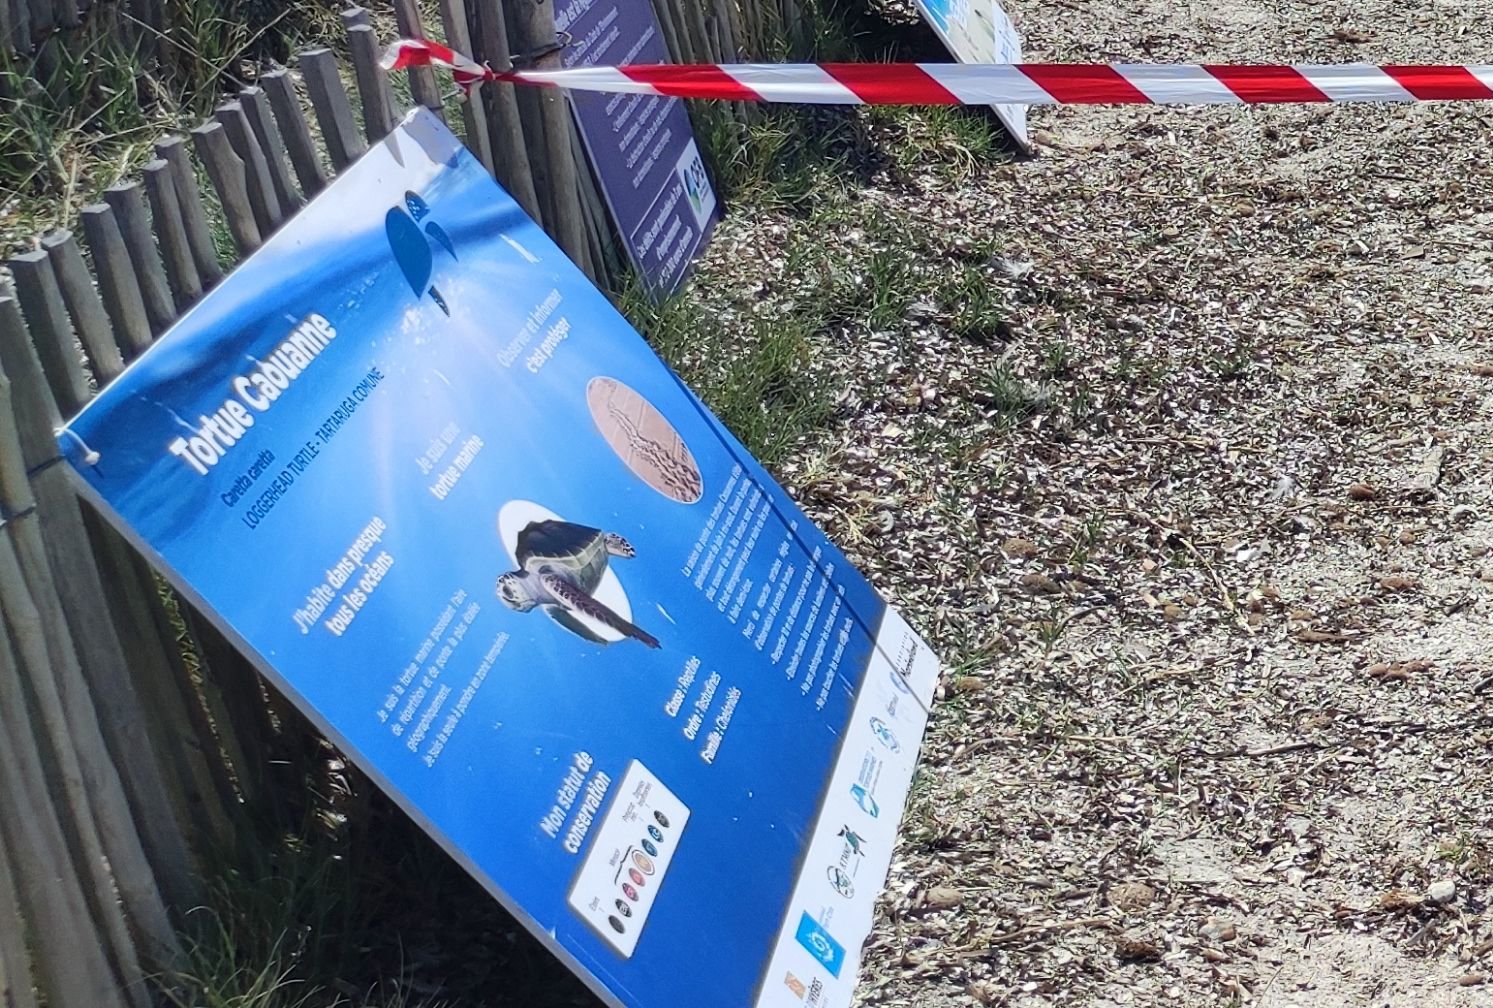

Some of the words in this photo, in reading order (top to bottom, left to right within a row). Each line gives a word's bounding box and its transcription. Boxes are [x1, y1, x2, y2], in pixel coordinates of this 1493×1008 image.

[525, 347, 547, 373] c'est
[537, 317, 570, 358] protéger
[169, 400, 253, 473] Tortue
[234, 314, 335, 410] Caouanne
[220, 474, 253, 507] Caretta
[247, 448, 275, 480] caretta
[241, 470, 294, 529] LOGGERHEAD
[286, 440, 320, 476] TURTLE
[314, 396, 358, 443] TARTARUGA
[351, 366, 385, 402] COMUNE
[414, 456, 434, 474] Je
[425, 433, 447, 462] suis
[439, 420, 460, 444] une
[429, 465, 460, 499] tortue
[452, 434, 483, 471] marine
[293, 583, 335, 633] J'habite
[326, 556, 355, 589] dans
[346, 516, 386, 566] presque
[324, 603, 355, 635] tous
[342, 587, 367, 611] les
[359, 550, 394, 592] océans
[539, 804, 566, 838] Mon
[557, 766, 585, 809] statut
[574, 751, 593, 772] de
[564, 771, 610, 853] conservation
